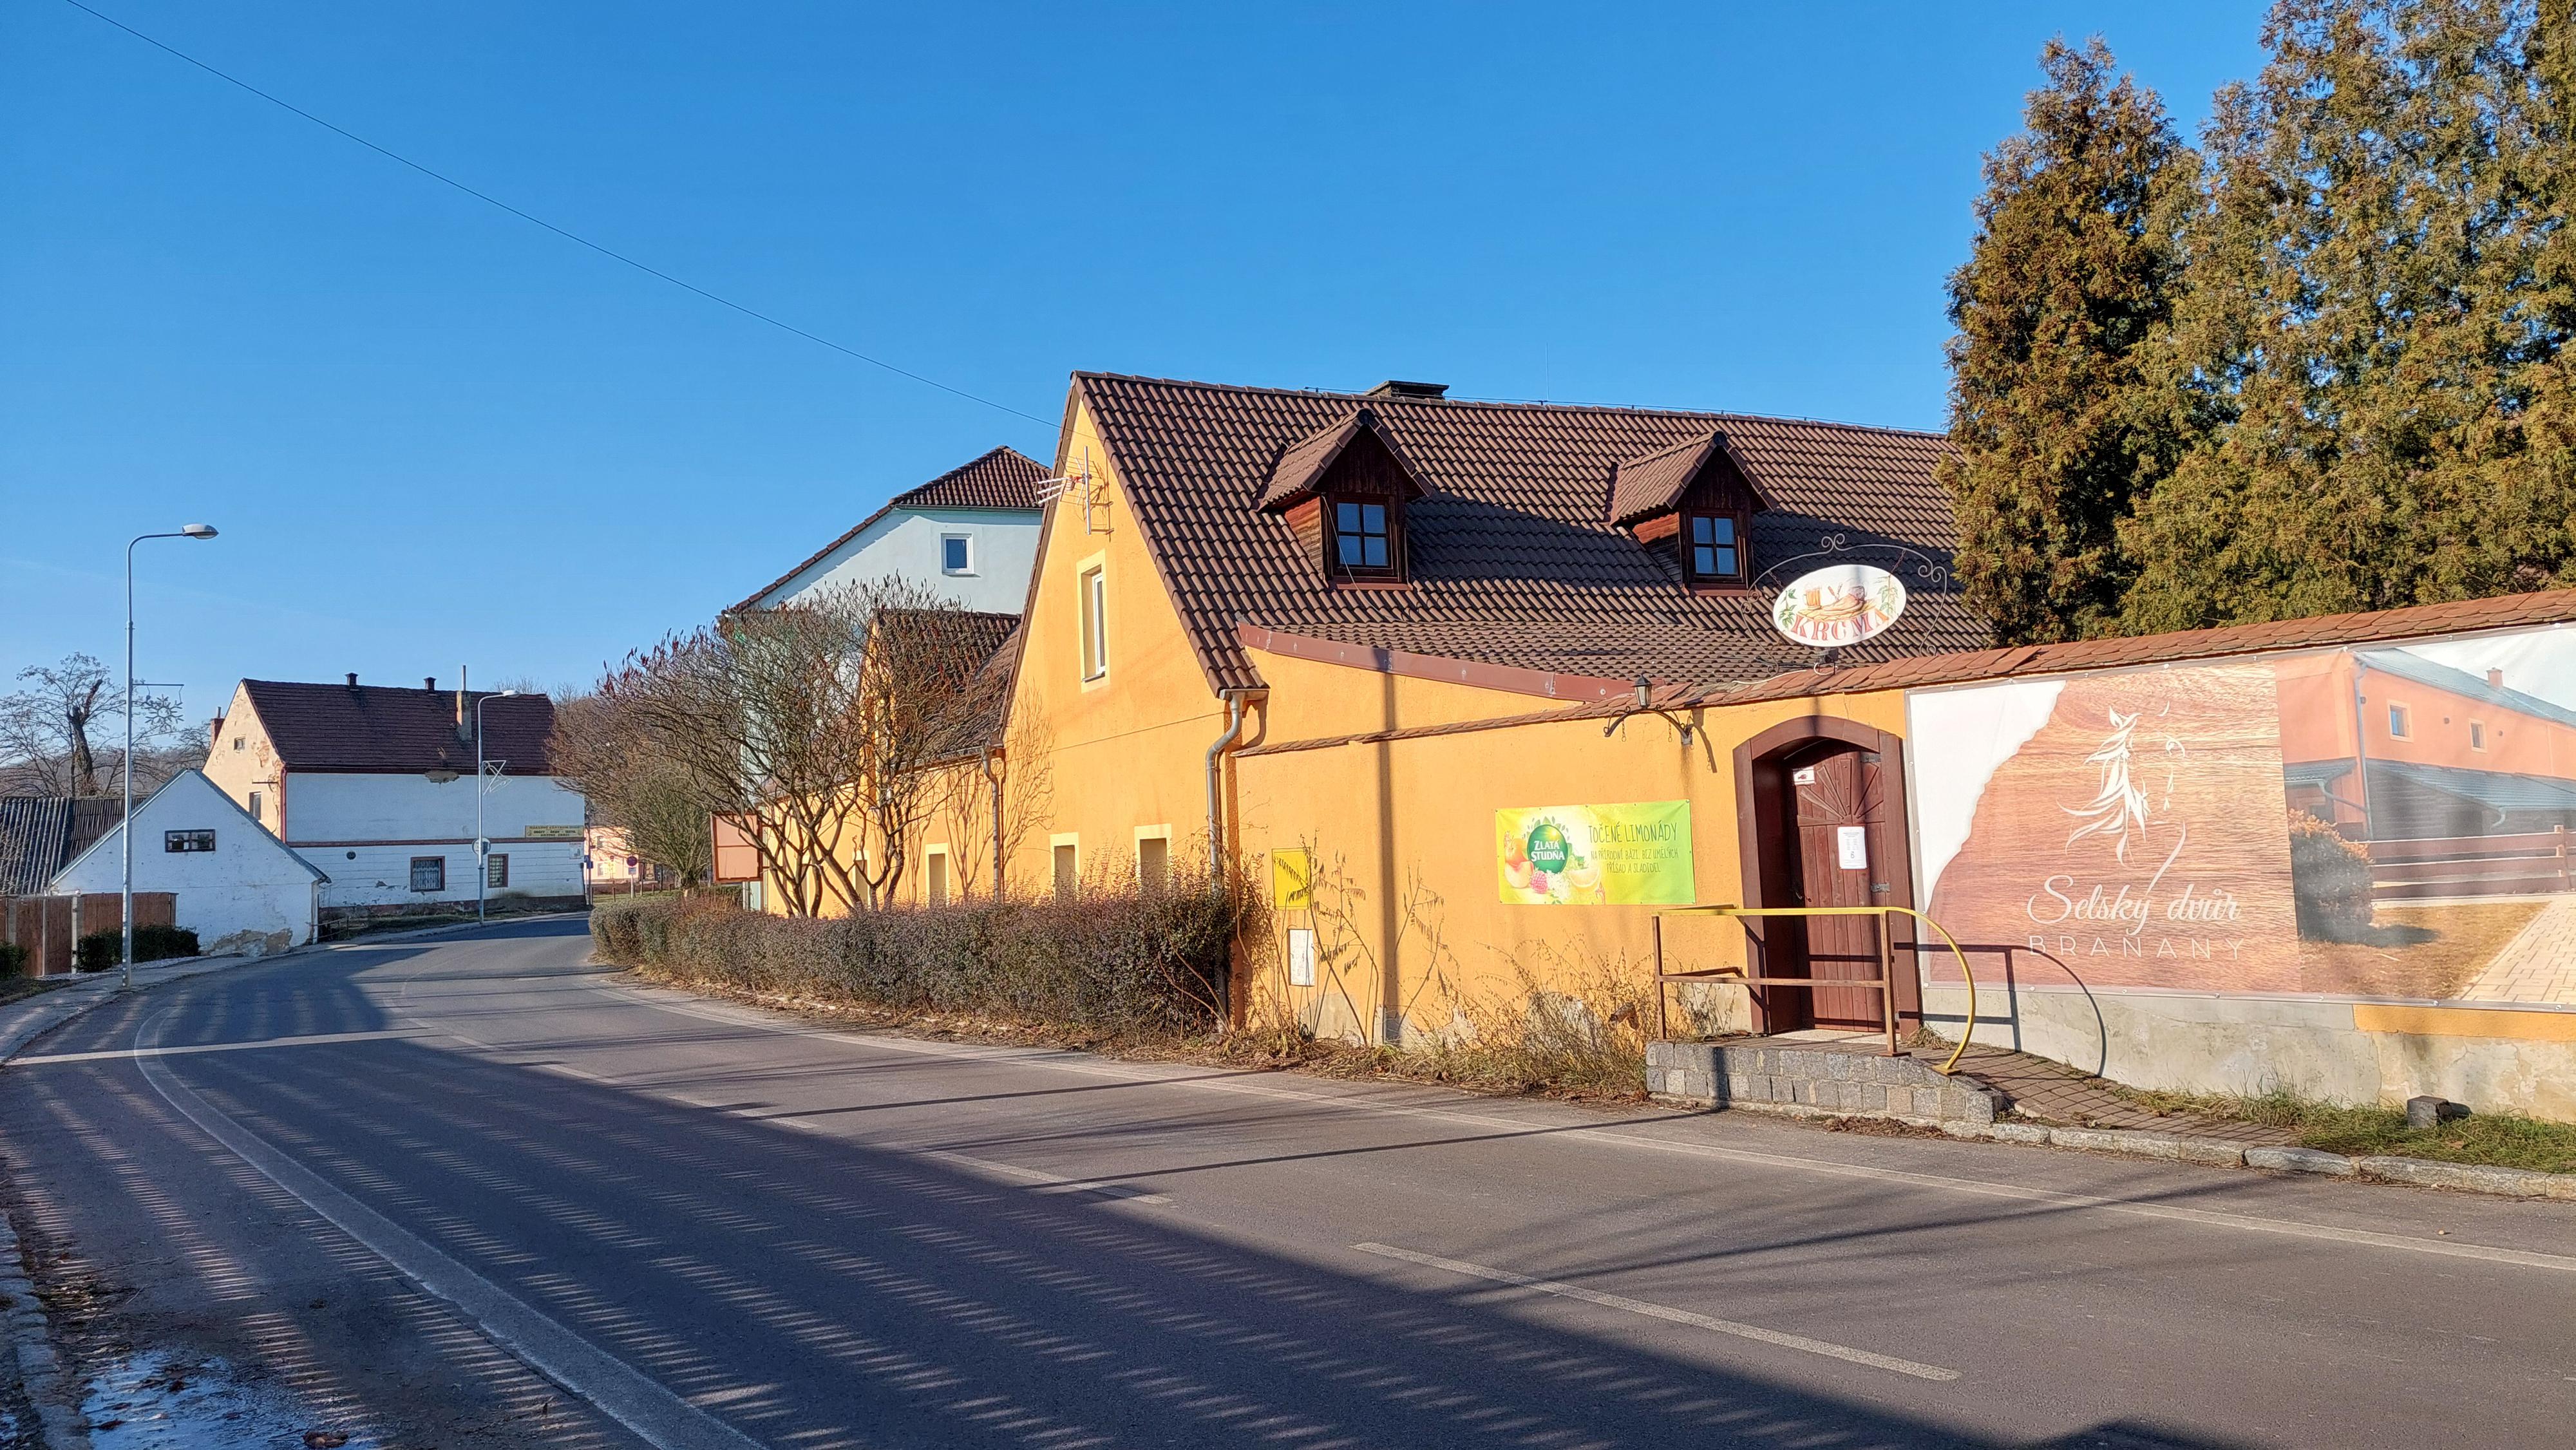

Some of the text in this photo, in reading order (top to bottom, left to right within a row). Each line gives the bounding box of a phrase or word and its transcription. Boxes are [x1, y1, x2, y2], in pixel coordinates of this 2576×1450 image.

[1588, 820, 1678, 843] TOČENÉ LIMONÁDY
[1534, 840, 1560, 851] ZLATÁ
[1591, 850, 1598, 860] NA
[1598, 847, 1623, 860] PŘÍRODNÍ
[1642, 849, 1651, 860] BEZ
[1607, 860, 1662, 873] PŘÍSAD A SLADIDEL
